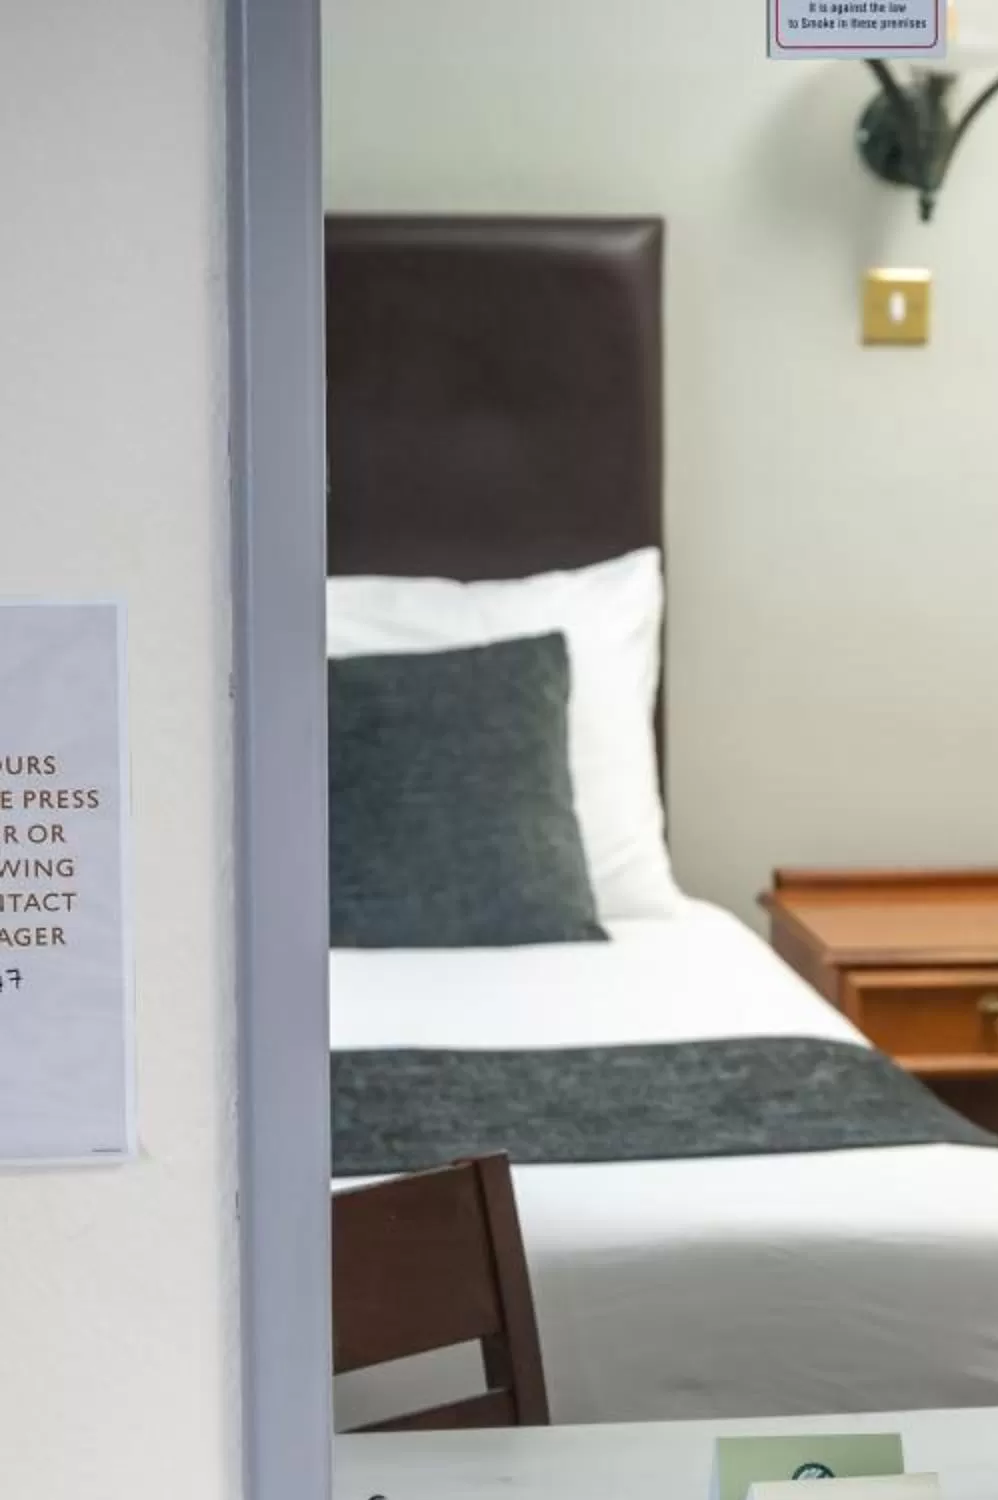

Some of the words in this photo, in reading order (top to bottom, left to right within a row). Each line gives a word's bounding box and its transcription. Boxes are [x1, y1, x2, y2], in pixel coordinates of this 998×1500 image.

[831, 3, 867, 15] against
[869, 3, 886, 13] the
[788, 19, 799, 29] to
[801, 17, 835, 29] Smoke
[851, 17, 877, 29] these
[880, 18, 928, 31] premises
[0, 755, 56, 775] URS
[23, 789, 99, 809] PRESS
[28, 823, 66, 844] OR
[0, 893, 77, 912] TACT
